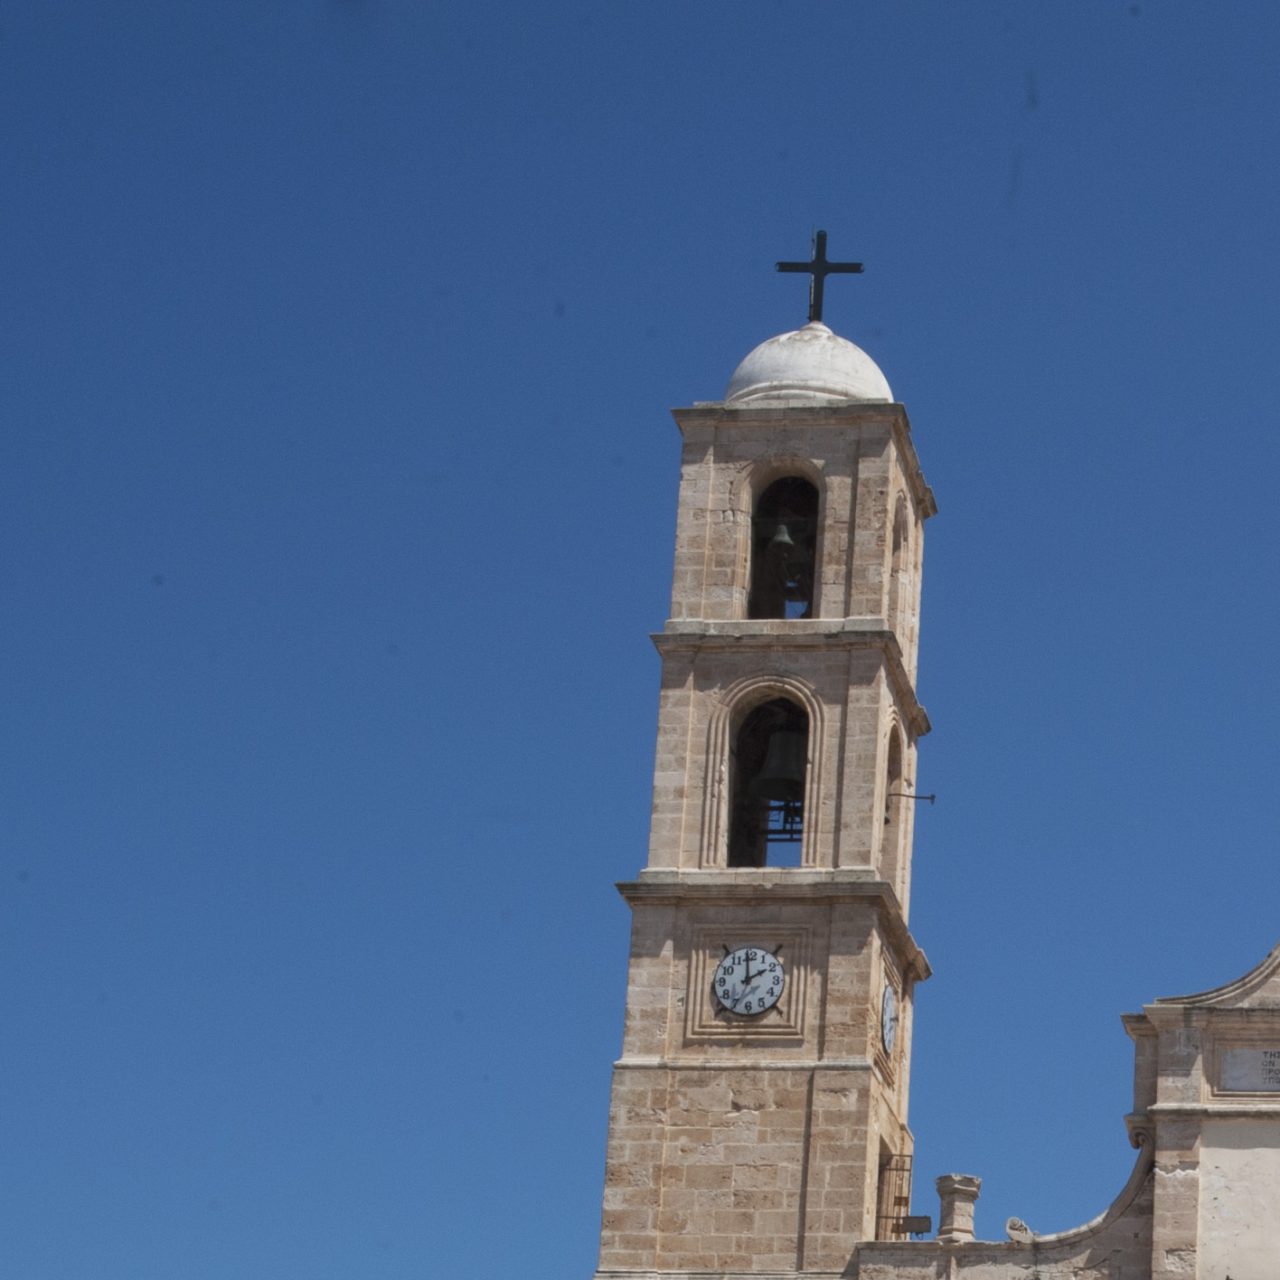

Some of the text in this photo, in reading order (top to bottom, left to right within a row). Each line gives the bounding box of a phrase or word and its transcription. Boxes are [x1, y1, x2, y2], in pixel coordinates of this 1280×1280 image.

[731, 956, 742, 965] 11
[723, 966, 734, 976] 10
[769, 962, 776, 972] 2
[719, 977, 726, 987] 9
[773, 976, 780, 985] 3
[723, 989, 730, 999] 8
[767, 987, 774, 997] 4
[731, 999, 740, 1009] 7
[745, 1001, 752, 1011] 6
[758, 998, 765, 1008] 5
